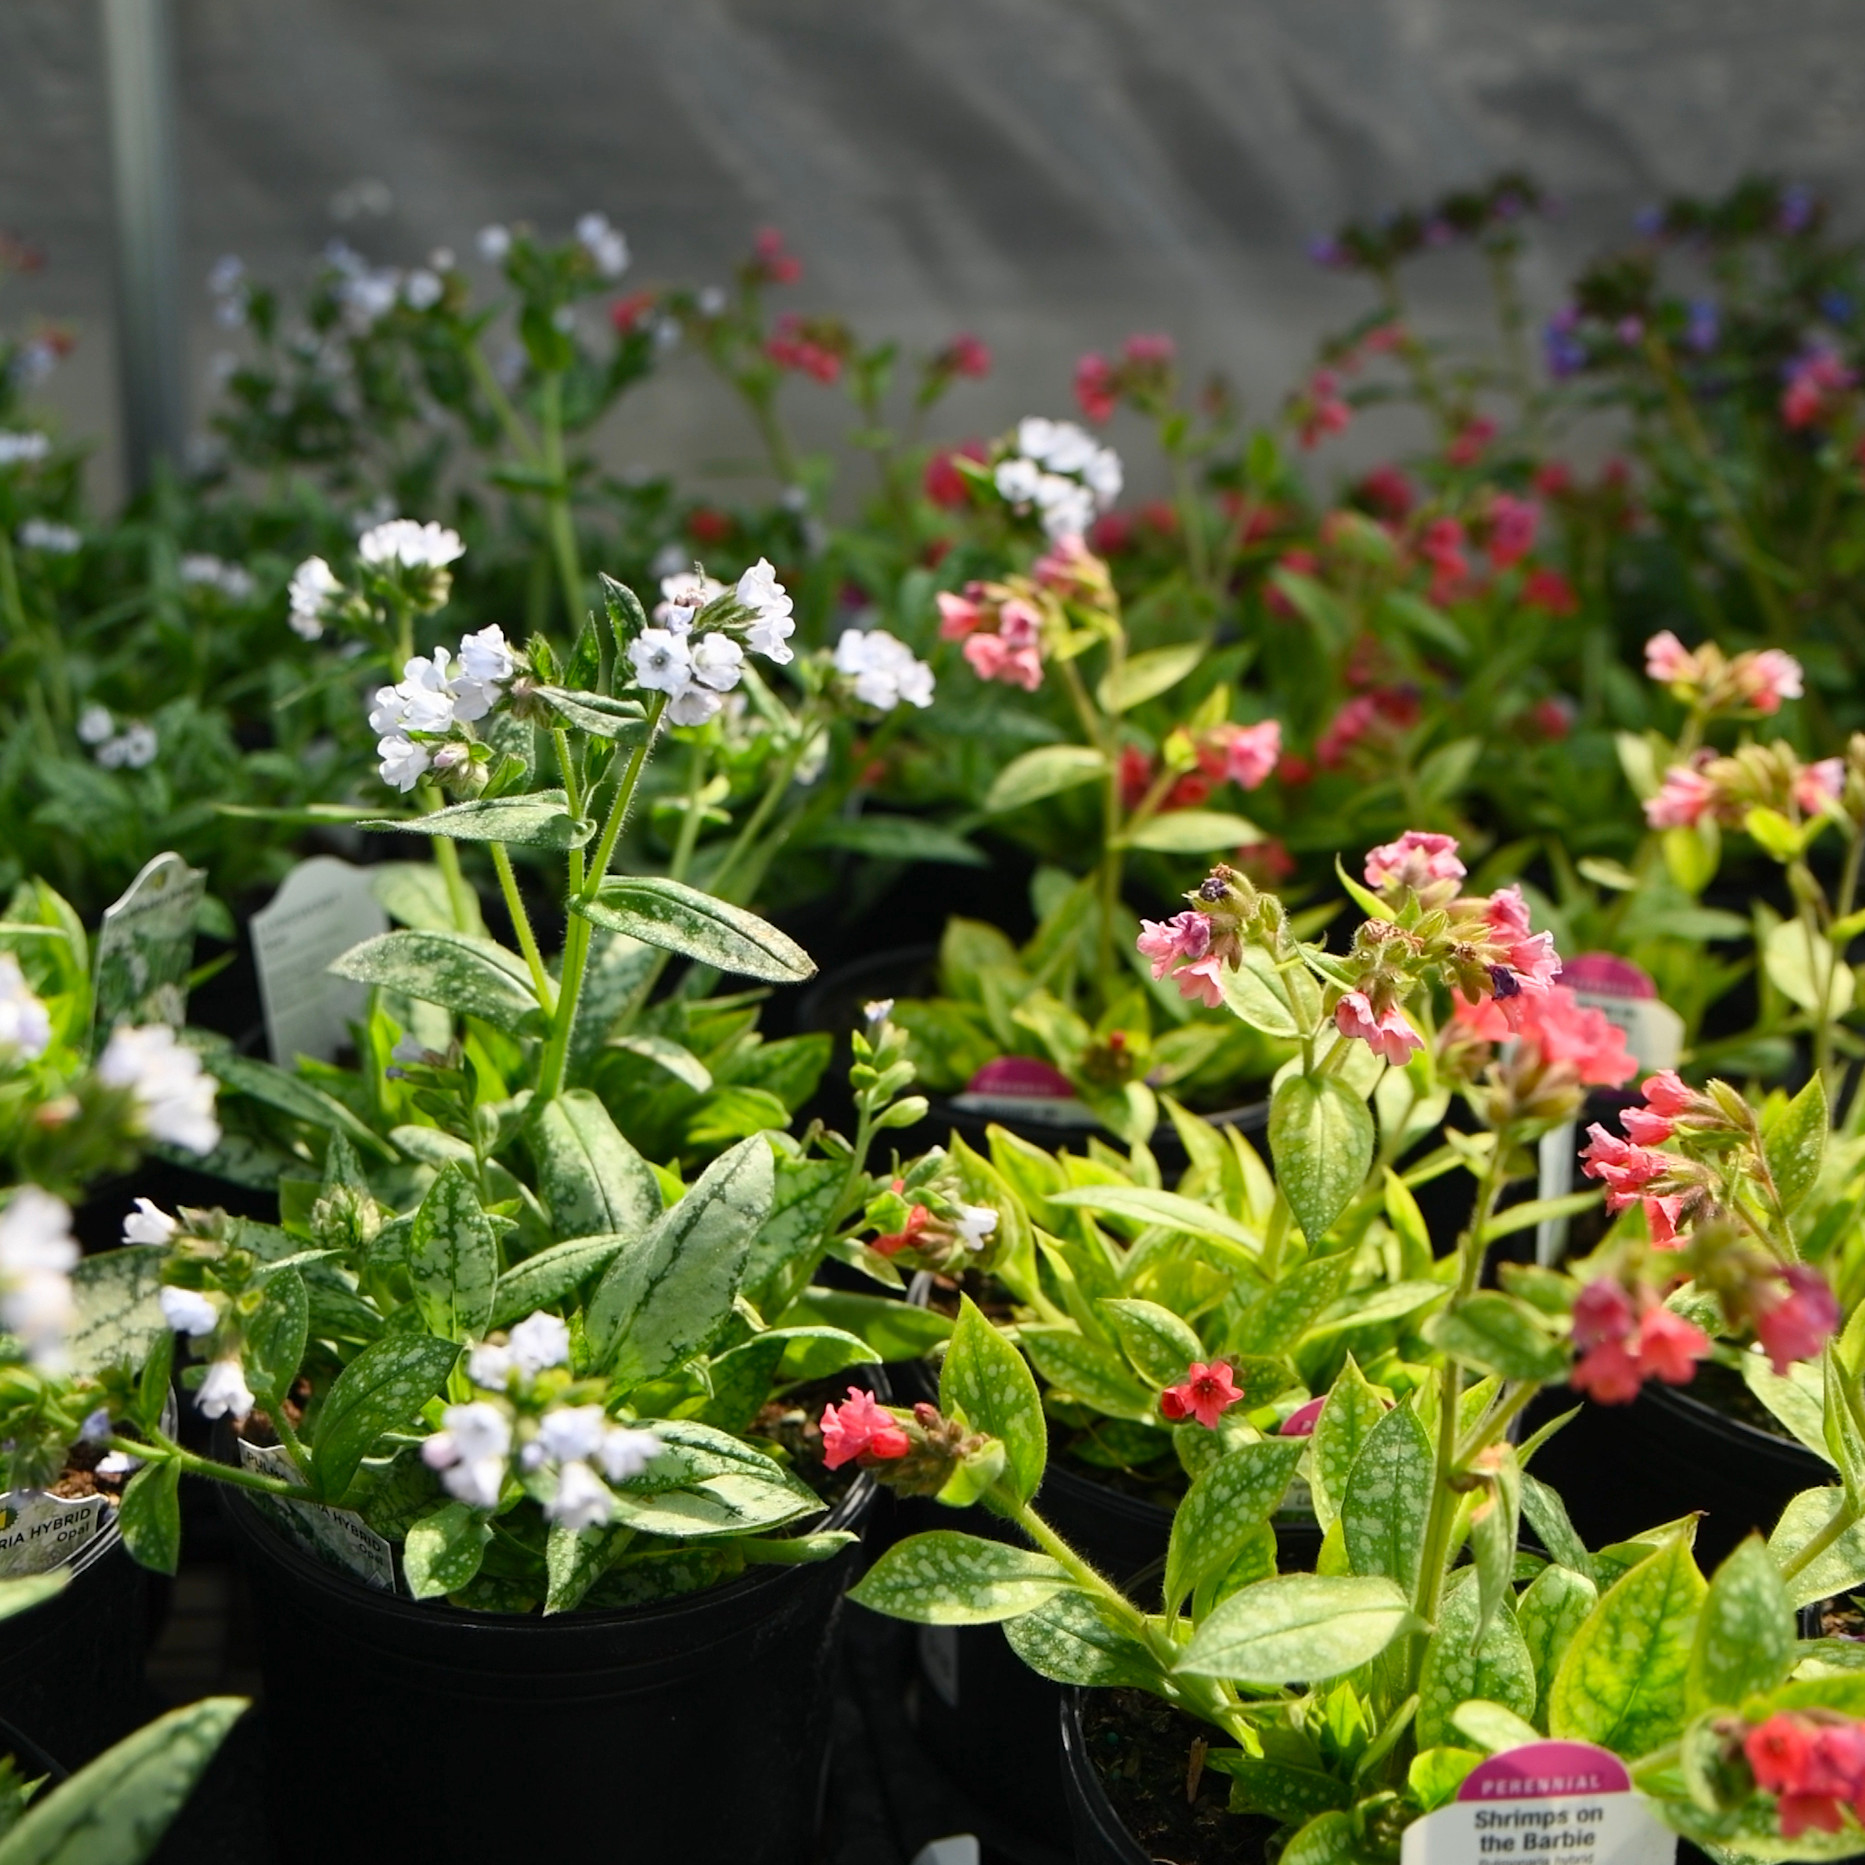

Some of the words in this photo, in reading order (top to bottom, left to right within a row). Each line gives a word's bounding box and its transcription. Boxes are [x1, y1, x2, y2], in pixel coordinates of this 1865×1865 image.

[31, 1508, 92, 1539] HYBRID
[57, 1522, 90, 1542] Opal
[333, 1511, 381, 1552] HYBRID
[1481, 1774, 1601, 1796] PERENNIAL
[1474, 1807, 1568, 1829] Shrimps
[1577, 1806, 1603, 1823] on
[1480, 1834, 1515, 1853] the
[1523, 1829, 1595, 1851] Barbie
